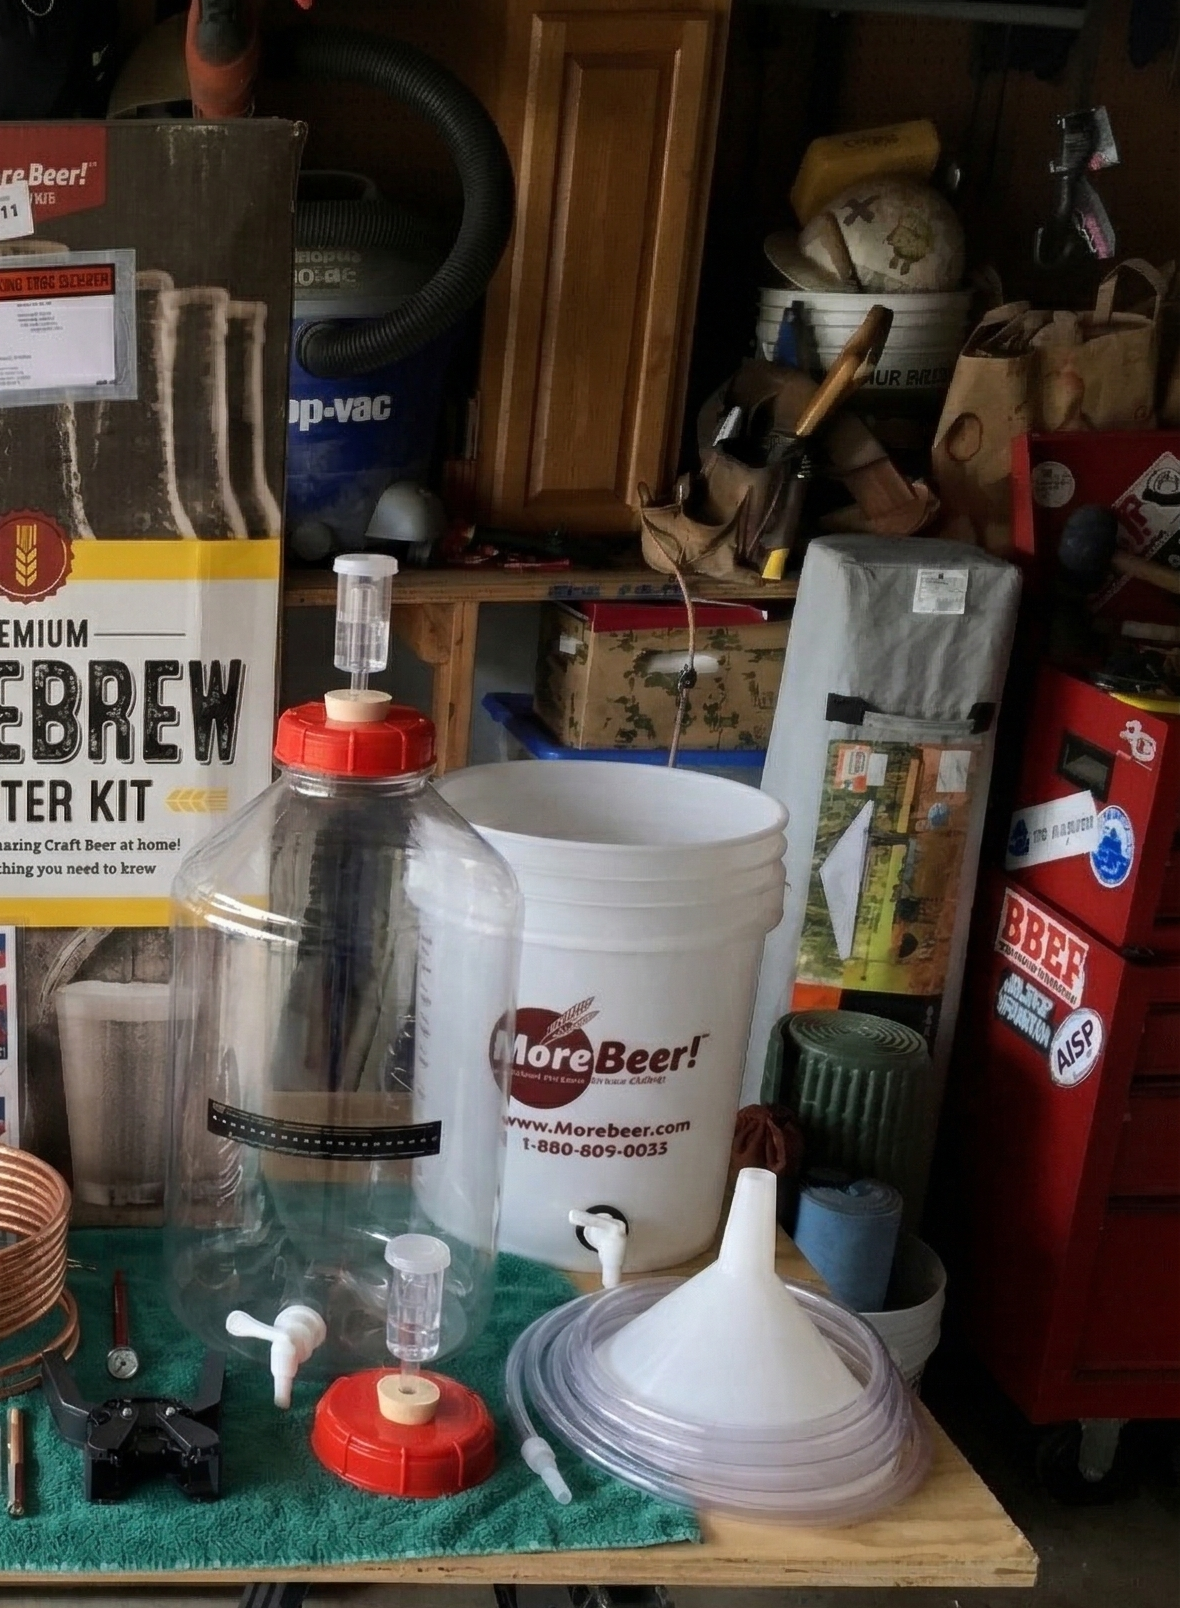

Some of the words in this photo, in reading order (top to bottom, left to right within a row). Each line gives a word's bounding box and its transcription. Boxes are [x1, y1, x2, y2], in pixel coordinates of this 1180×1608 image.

[89, 779, 153, 823] KIT
[44, 838, 82, 852] Craft
[84, 839, 117, 852] Beer
[119, 840, 134, 852] at
[137, 838, 182, 852] home!
[37, 865, 64, 879] you
[66, 861, 100, 876] need
[103, 862, 118, 876] to
[120, 861, 157, 876] krew
[1056, 1018, 1095, 1076] AISP
